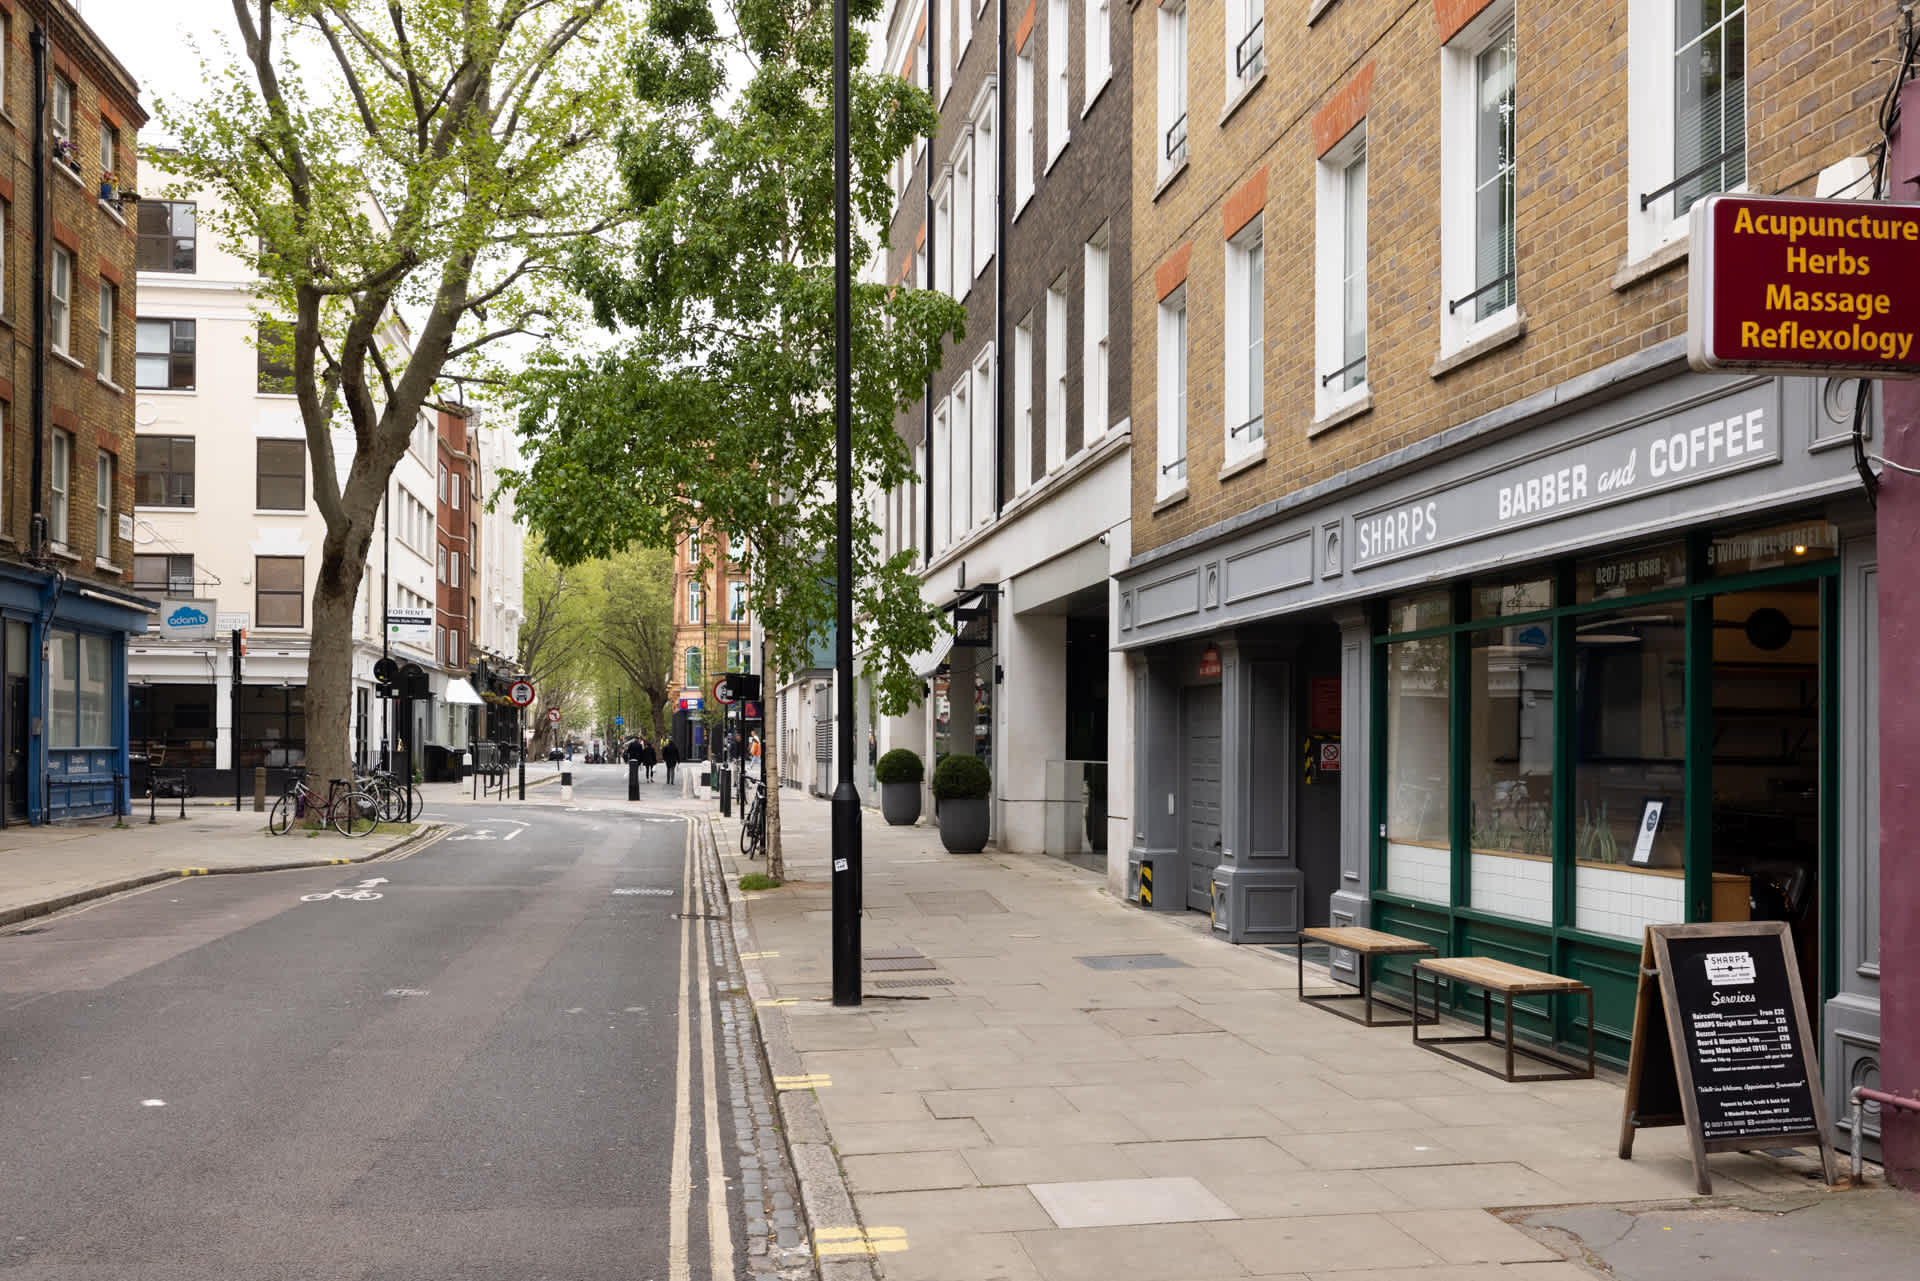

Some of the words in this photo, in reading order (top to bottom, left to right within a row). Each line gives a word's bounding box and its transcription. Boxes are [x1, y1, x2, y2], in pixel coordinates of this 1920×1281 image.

[1734, 207, 1919, 242] Acupuncture
[1787, 247, 1871, 276] Herbs
[1765, 284, 1890, 320] Massage
[1741, 321, 1913, 360] Reflexology
[1359, 501, 1438, 559] SHARPS
[1498, 463, 1588, 520] BARBER
[1597, 449, 1637, 493] and
[1649, 408, 1765, 478] COFFEE
[169, 614, 198, 625] adam
[198, 614, 206, 624] b
[1711, 954, 1747, 965] SHARPS
[1711, 991, 1756, 1006] Services
[1692, 1012, 1722, 1020] Haircutting
[1715, 1020, 1736, 1028] Straight
